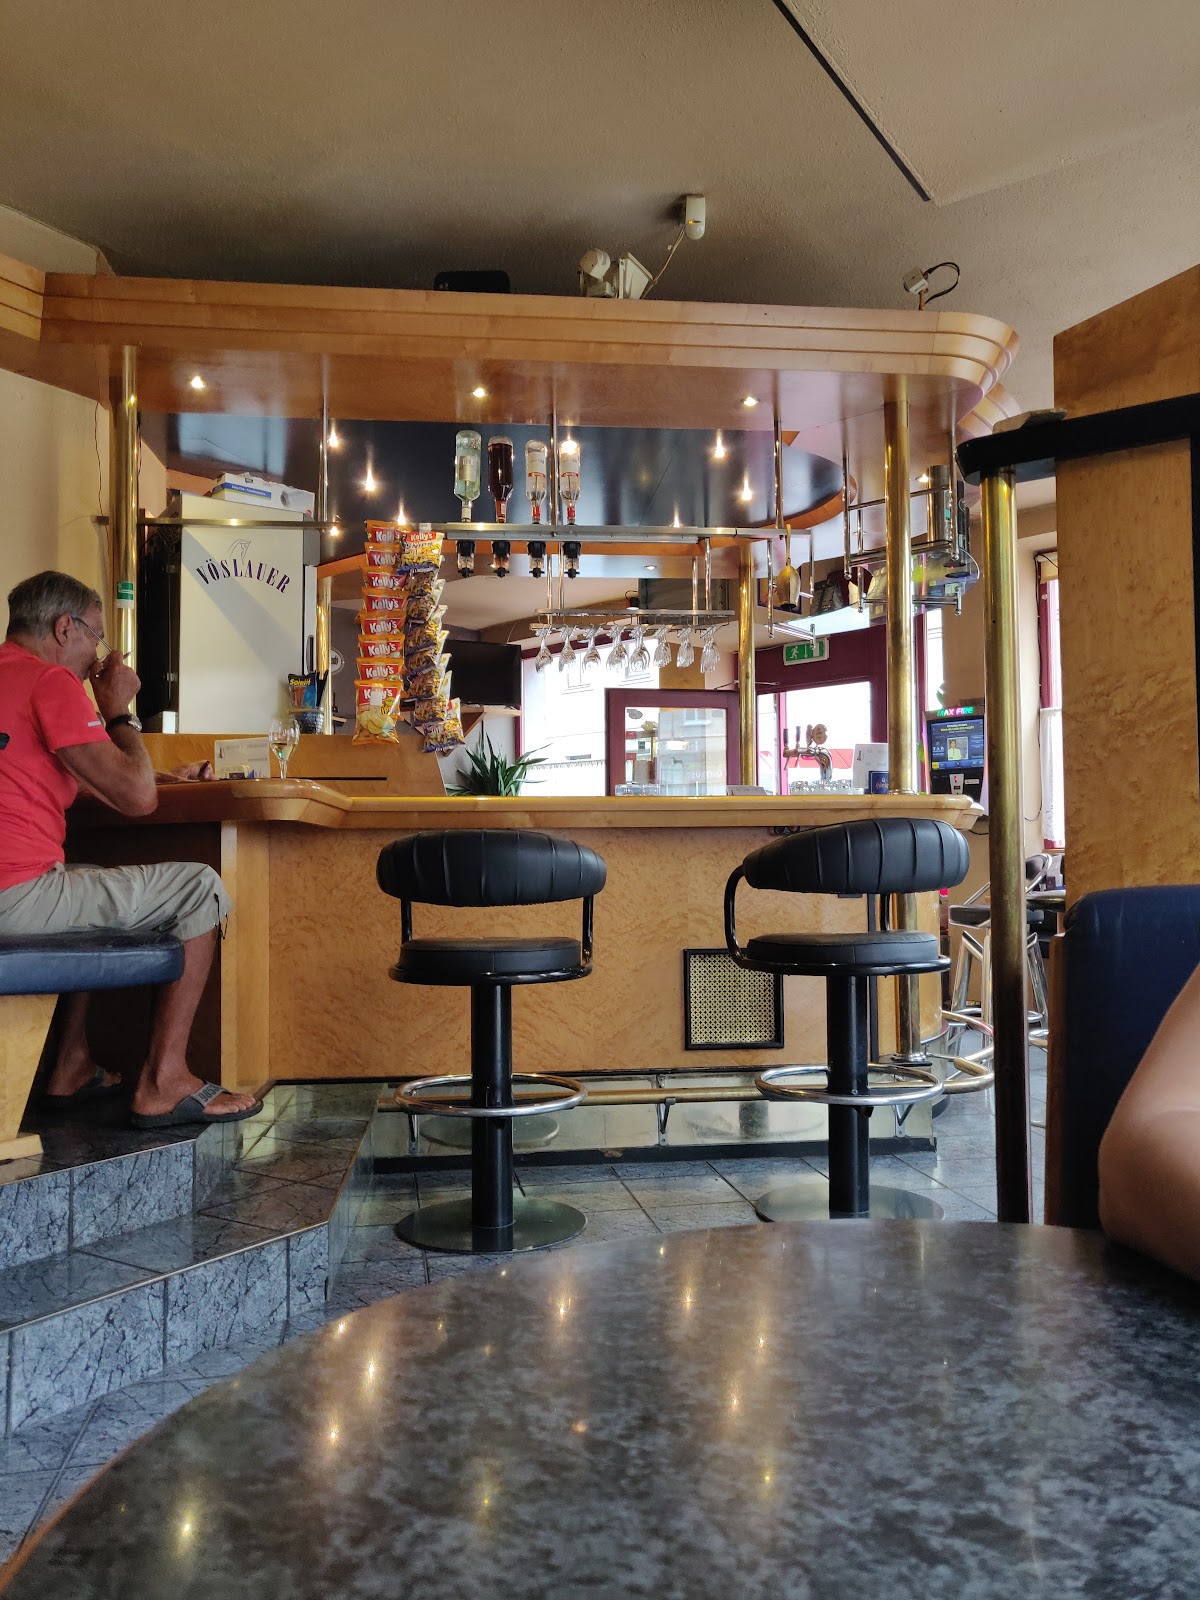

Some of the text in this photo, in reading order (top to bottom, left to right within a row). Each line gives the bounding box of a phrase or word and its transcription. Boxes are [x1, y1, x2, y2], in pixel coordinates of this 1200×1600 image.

[411, 532, 433, 542] Kelly's
[196, 558, 291, 594] VÖSLAUER
[371, 576, 400, 589] Kelly's
[371, 598, 399, 611] Kelly's
[369, 620, 398, 634] Kelly's
[367, 642, 397, 657] Kelly's
[365, 665, 395, 679] Kelly's
